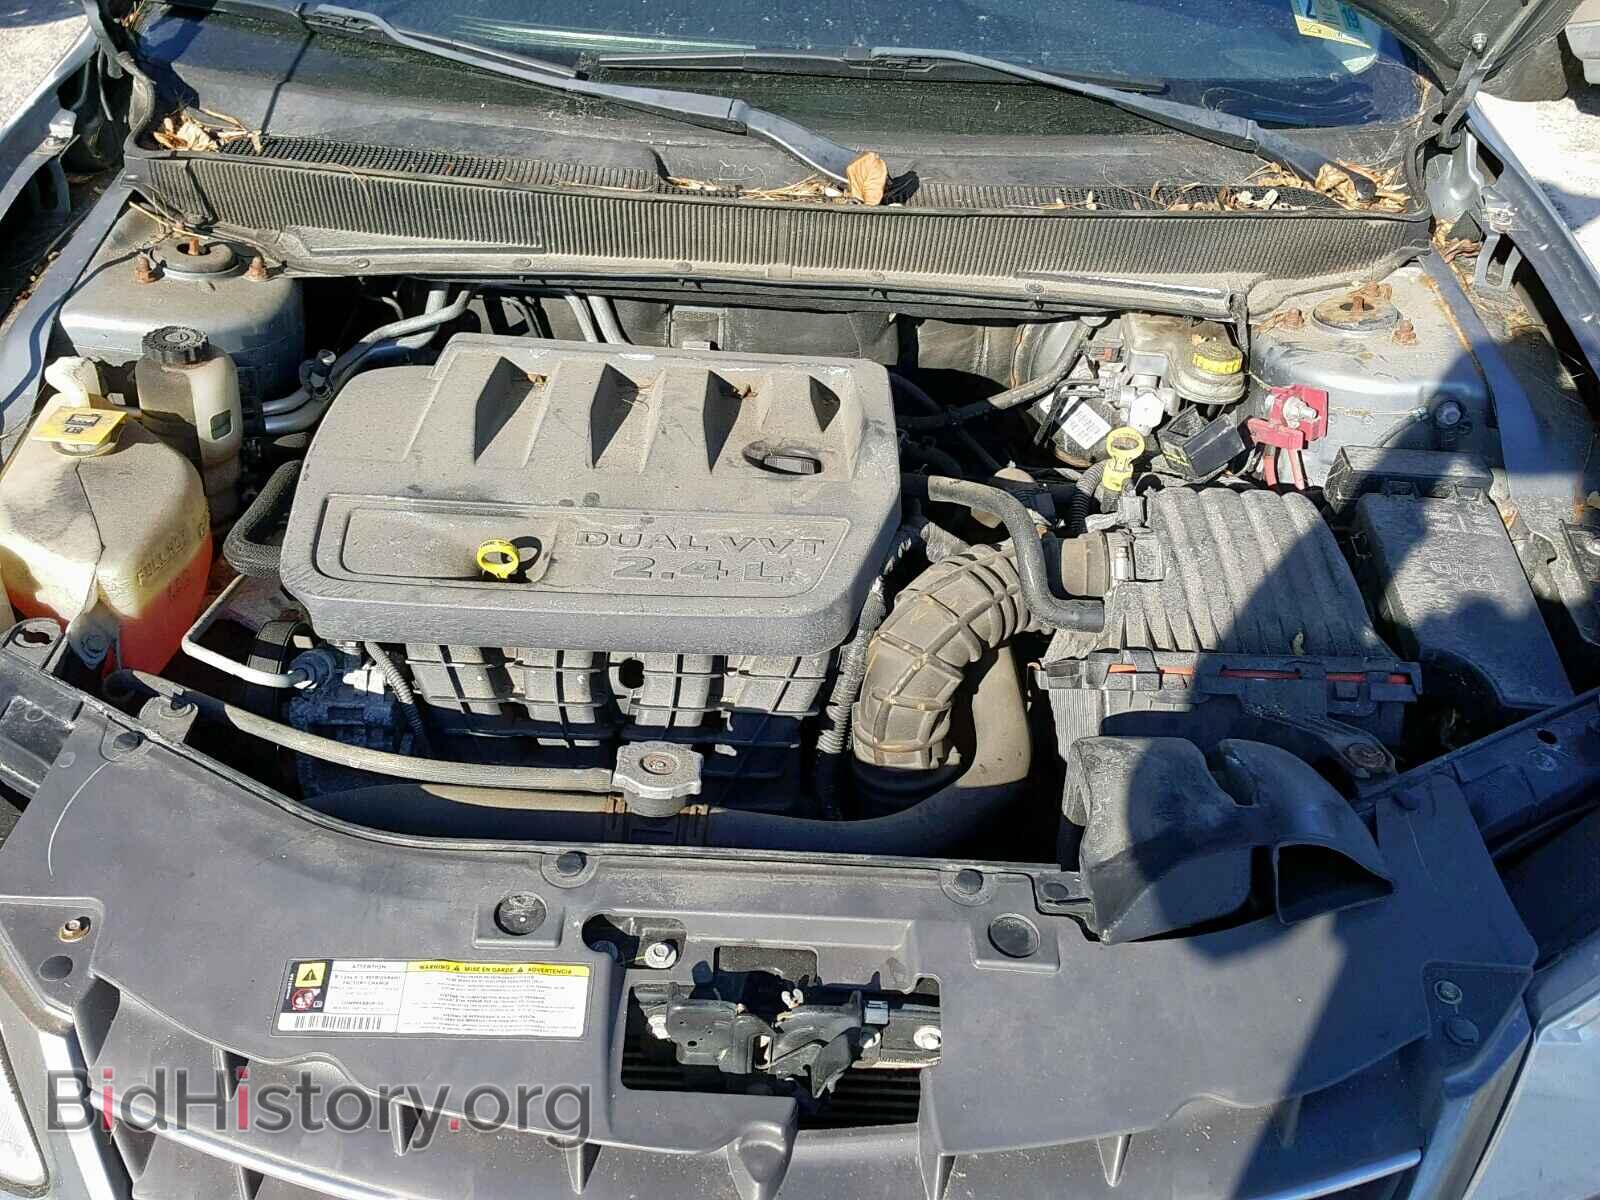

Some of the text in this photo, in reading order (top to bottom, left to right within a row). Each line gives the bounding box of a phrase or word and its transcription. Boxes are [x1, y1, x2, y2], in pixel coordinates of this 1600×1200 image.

[575, 530, 825, 556] DUAL VVT
[527, 966, 573, 975] ADVERTENCIA
